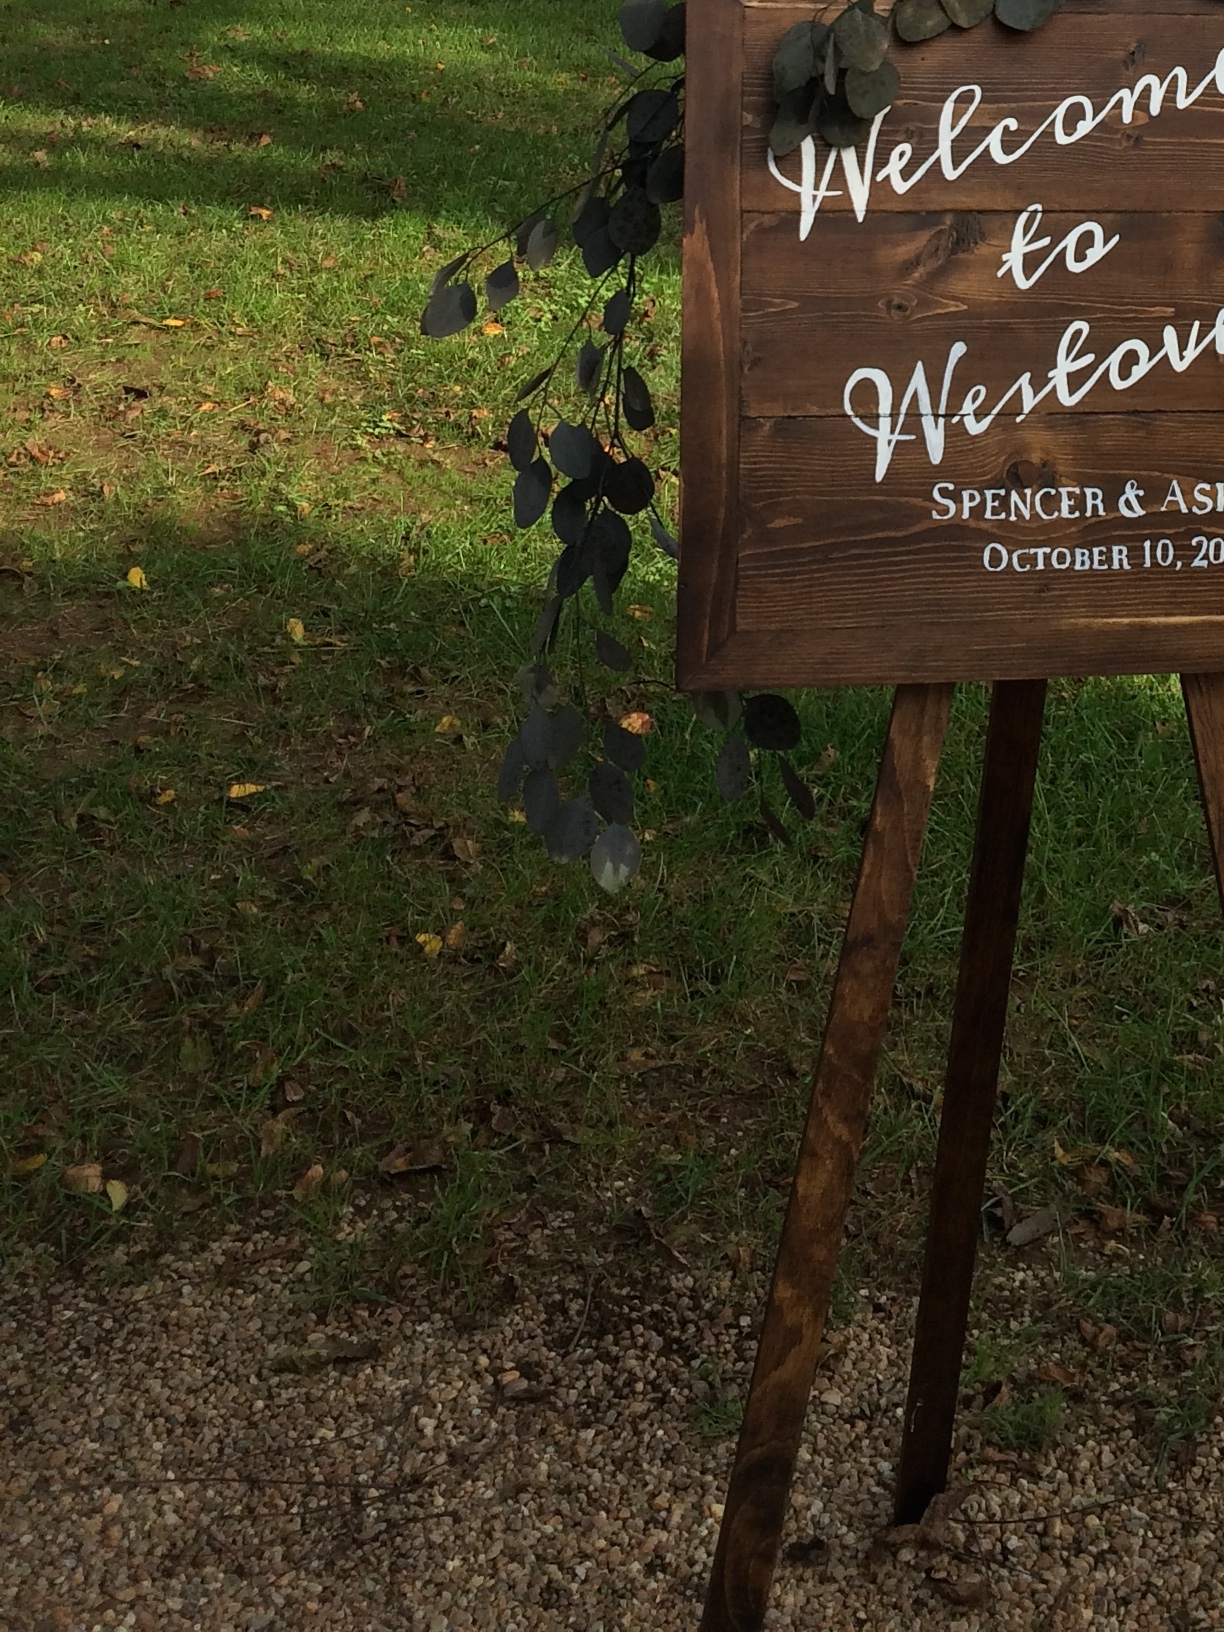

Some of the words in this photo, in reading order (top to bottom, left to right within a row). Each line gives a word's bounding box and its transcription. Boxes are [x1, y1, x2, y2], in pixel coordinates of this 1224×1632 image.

[996, 203, 1121, 290] to
[931, 482, 1107, 522] SPENCER
[1117, 479, 1147, 518] &
[983, 542, 1132, 572] OCTOBER
[1142, 538, 1183, 571] 10,
